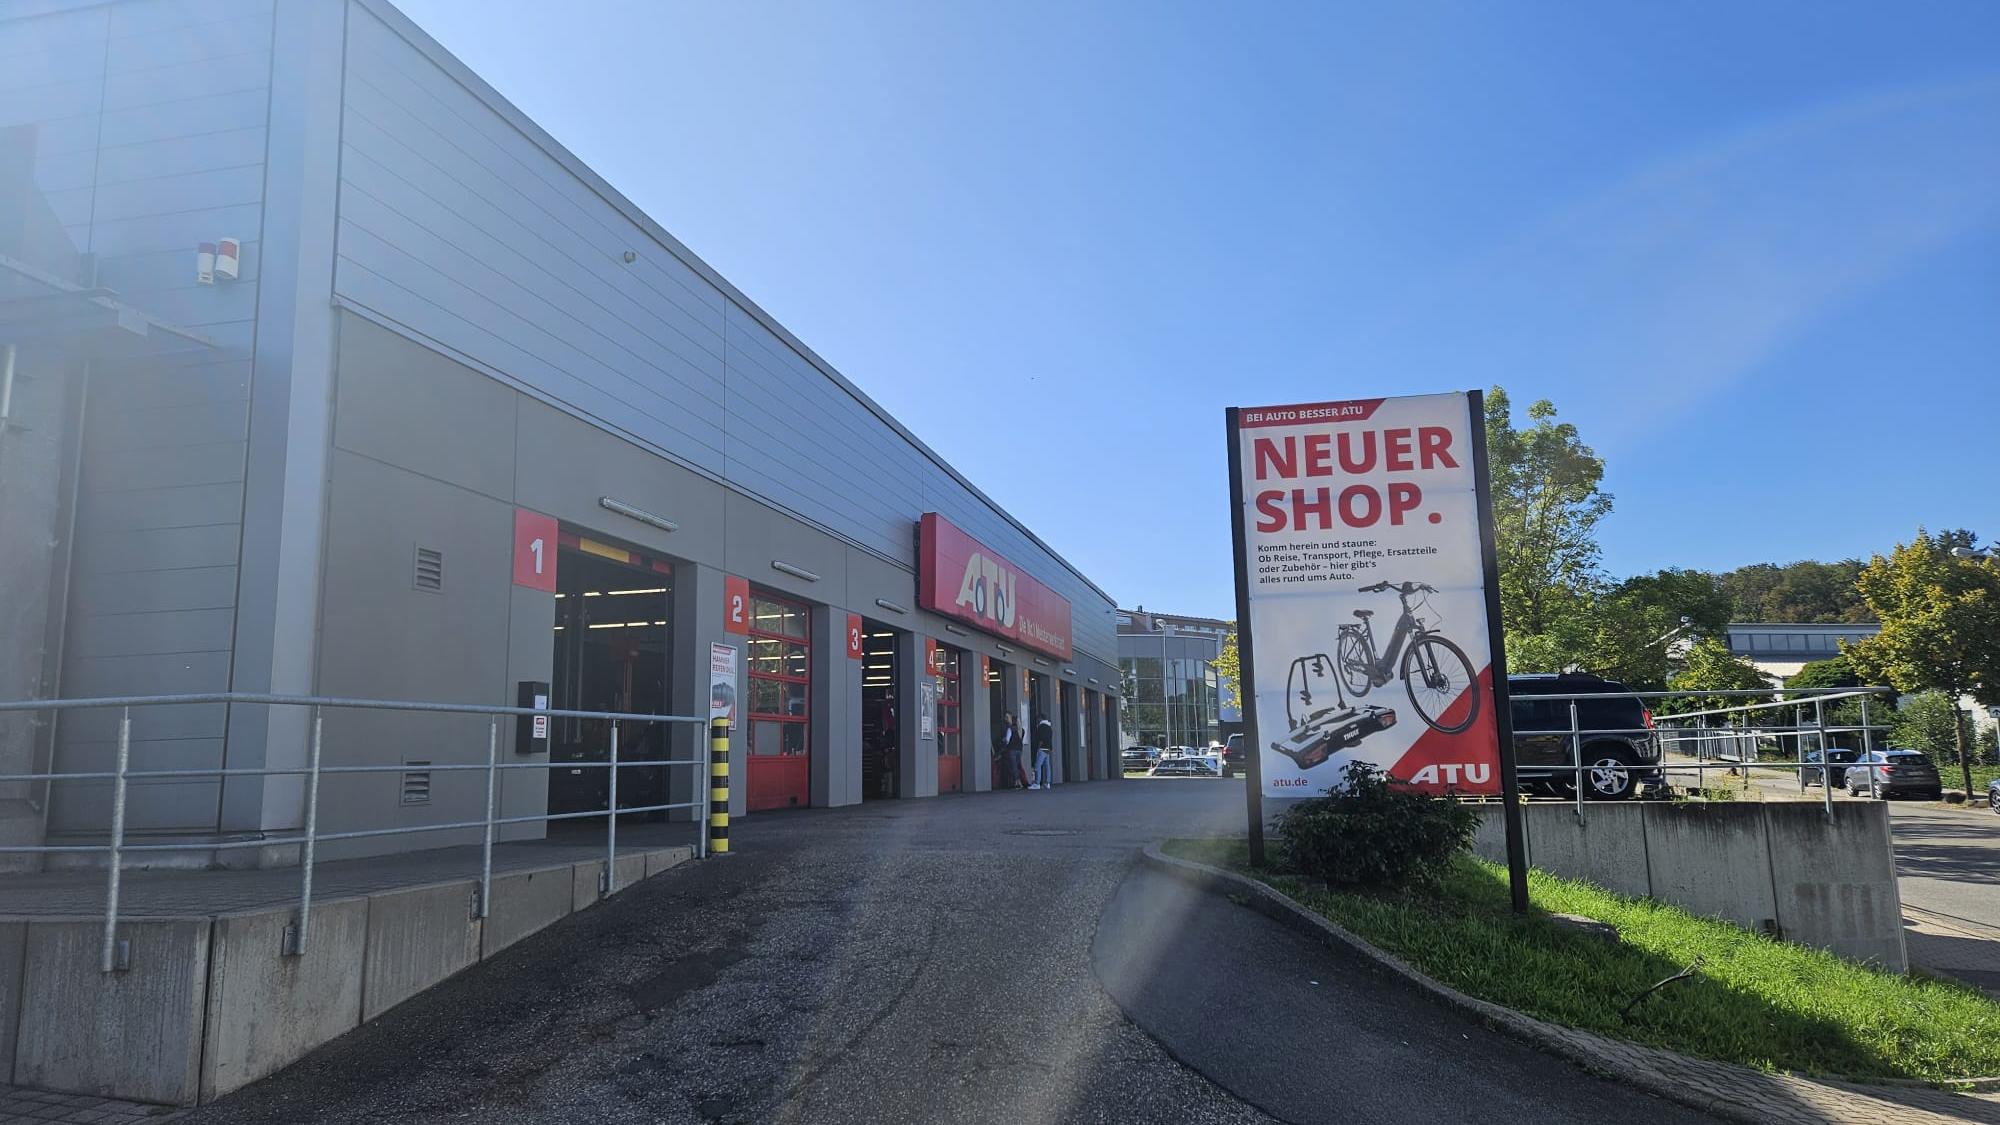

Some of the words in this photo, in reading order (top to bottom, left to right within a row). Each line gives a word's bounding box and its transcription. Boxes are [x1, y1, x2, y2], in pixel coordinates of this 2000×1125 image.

[1246, 413, 1263, 422] BEI
[1266, 411, 1296, 421] AUTO
[1299, 407, 1339, 419] BESSER
[1341, 406, 1363, 416] ATU
[1254, 426, 1460, 480] NEUER
[1255, 482, 1442, 533] SHOP.
[1257, 544, 1287, 552] Komm
[1290, 542, 1320, 551] herein
[1321, 541, 1340, 550] und
[1342, 539, 1377, 549] staune:
[530, 538, 543, 574] 1
[1258, 555, 1271, 563] Ob
[1274, 553, 1300, 563] Reise,
[1303, 551, 1351, 561] Transport,
[1353, 549, 1385, 559] Pflege,
[1387, 546, 1438, 557] Ersatzteile
[1259, 564, 1280, 573] oder
[1282, 562, 1321, 573] Zubehör
[1330, 561, 1349, 571] hier
[1259, 576, 1281, 584] alles
[1283, 574, 1305, 583] rund
[1307, 574, 1327, 582] ums
[1329, 572, 1355, 582] Auto.
[956, 553, 1016, 628] ATU
[732, 595, 742, 623] 2
[851, 627, 859, 644] 3
[928, 654, 935, 669] 4
[1273, 777, 1308, 788] atu.de
[1409, 763, 1490, 784] ATU
